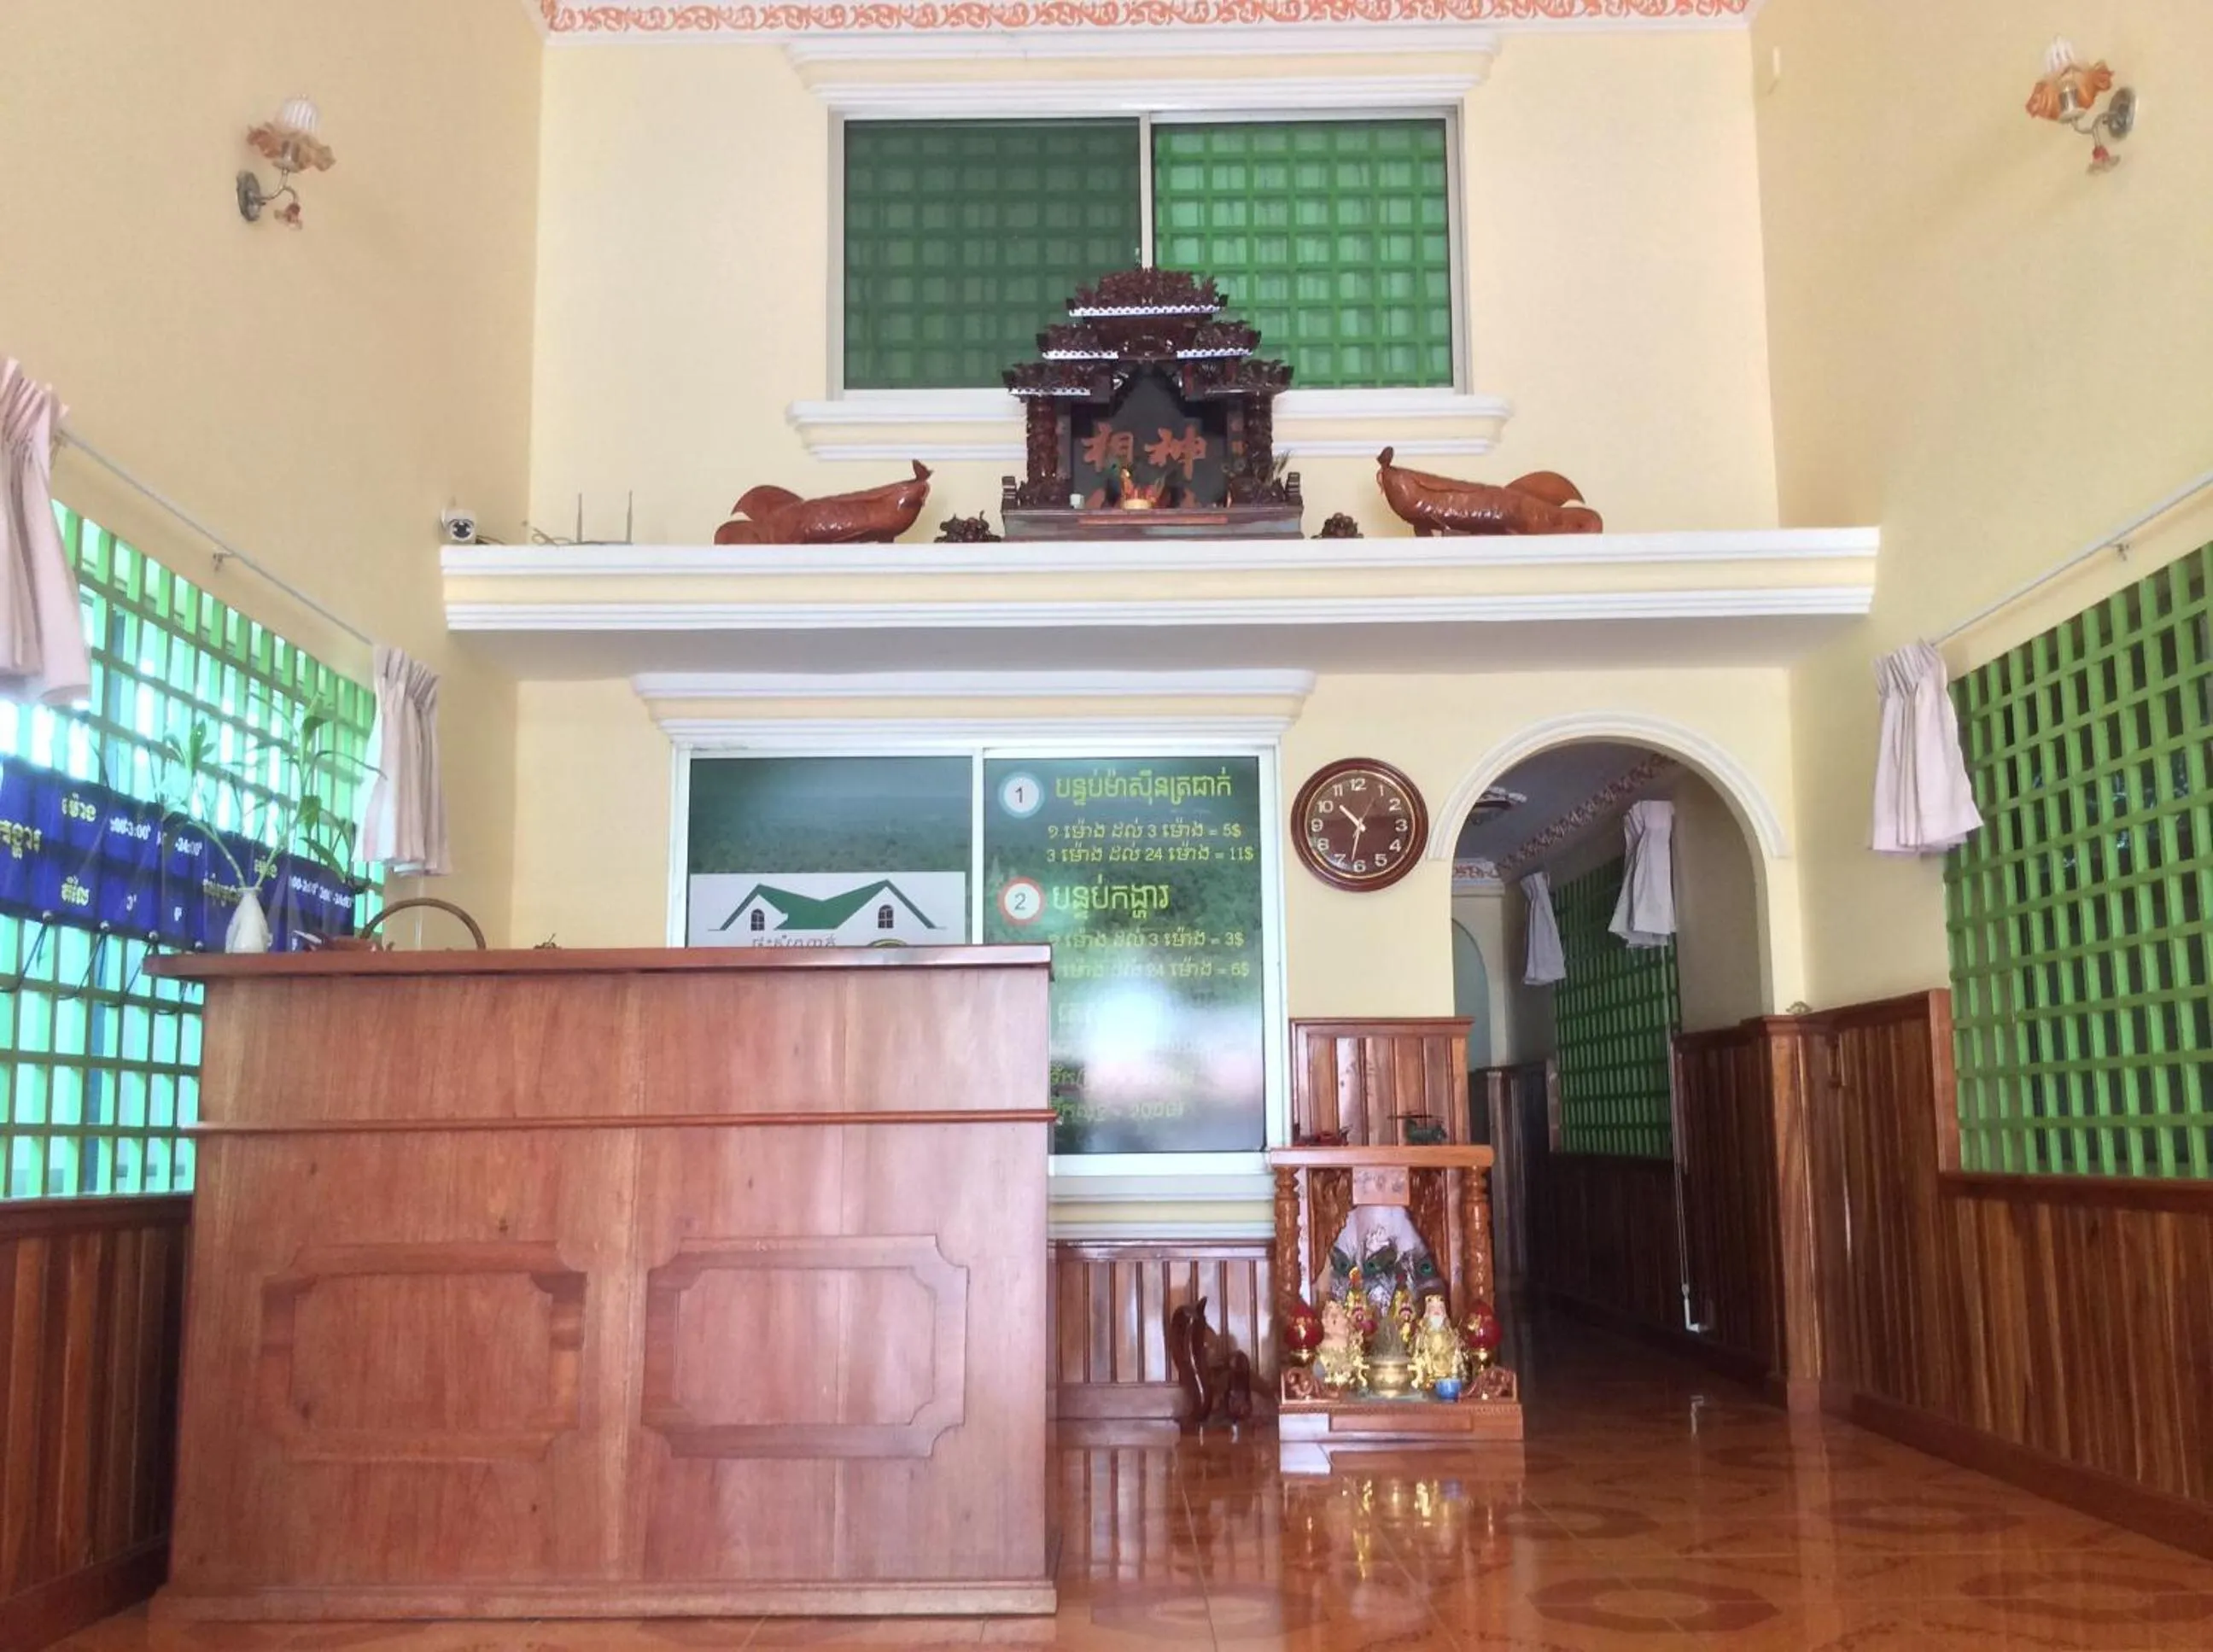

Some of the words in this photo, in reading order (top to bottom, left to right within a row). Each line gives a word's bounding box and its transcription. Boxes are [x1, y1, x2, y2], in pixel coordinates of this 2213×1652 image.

[1333, 784, 1343, 797] 11
[1350, 778, 1366, 791] 12
[1379, 785, 1384, 797] 1
[1015, 786, 1023, 803] 1
[1317, 800, 1334, 814] 10
[1389, 797, 1401, 811] 2
[1147, 824, 1157, 838] 3
[1223, 822, 1241, 838] 5$
[1311, 819, 1323, 832] 9
[1395, 819, 1408, 832] 3
[1317, 838, 1329, 850] 8
[1389, 838, 1401, 852] 4
[1046, 848, 1055, 862] 3
[1145, 847, 1162, 861] 24
[1229, 846, 1253, 861] 11$
[1334, 854, 1346, 867] 7
[1375, 854, 1387, 867] 5
[1353, 860, 1366, 873] 6
[1014, 892, 1026, 910] 2
[1148, 932, 1159, 946] 3
[1224, 931, 1244, 948] 3$
